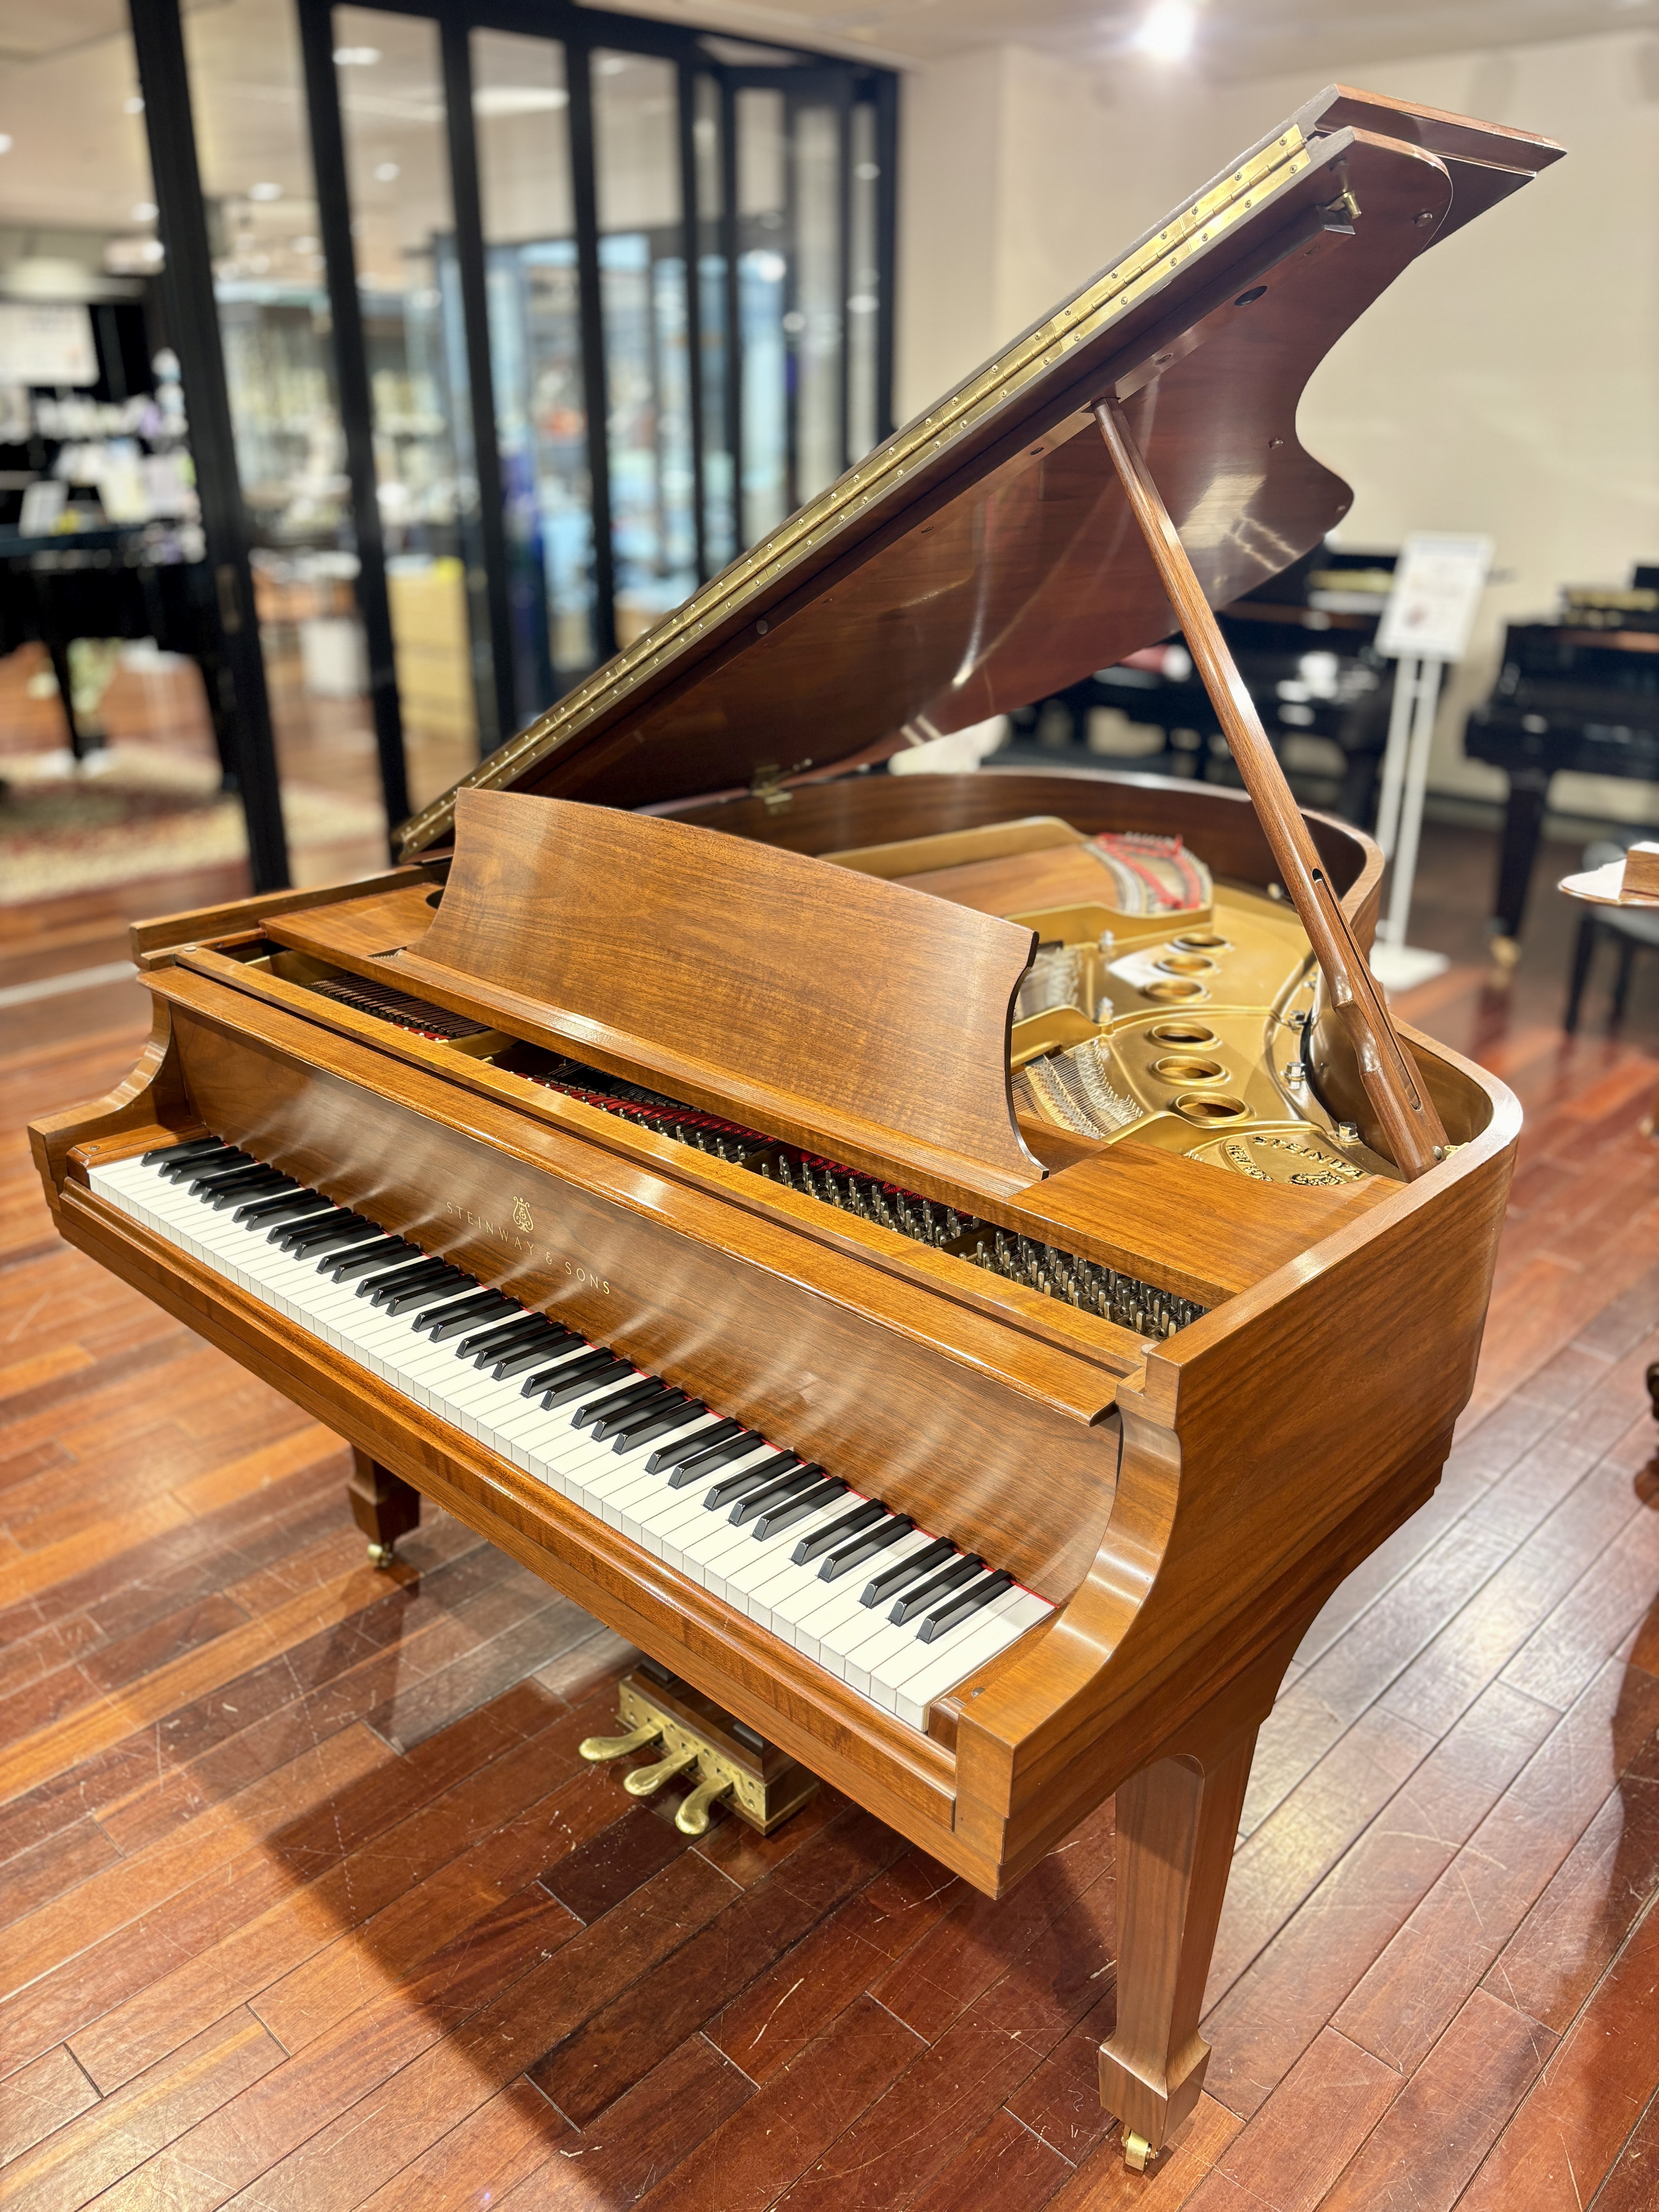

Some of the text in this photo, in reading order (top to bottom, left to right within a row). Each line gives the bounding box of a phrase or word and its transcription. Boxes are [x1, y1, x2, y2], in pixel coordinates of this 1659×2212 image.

[447, 1202, 610, 1295] STEINWAY & SONS
